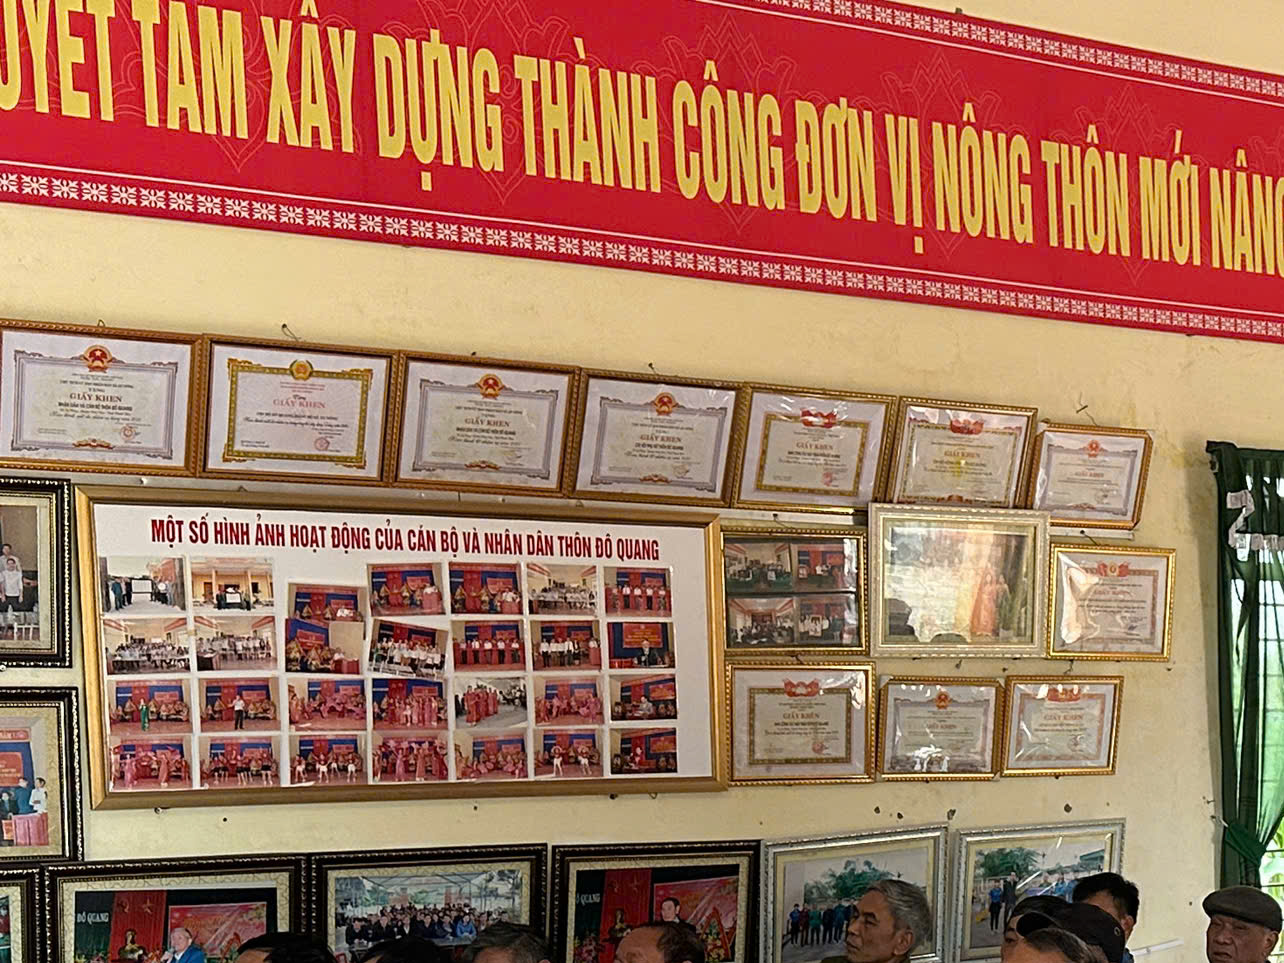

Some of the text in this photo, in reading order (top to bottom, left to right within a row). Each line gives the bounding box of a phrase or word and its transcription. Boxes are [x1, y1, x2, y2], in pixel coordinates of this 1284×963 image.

[262, 0, 355, 152] XÂY
[375, 30, 504, 189] DỰNG
[516, 40, 659, 191] THÀNH
[675, 64, 784, 208] CÔNG
[796, 98, 877, 221] ĐƠN
[887, 116, 923, 254] VỊ
[932, 102, 1033, 243] NÔNG
[1042, 125, 1130, 256] THÔN
[1140, 130, 1200, 265] MỚI
[69, 392, 92, 401] GIẤY
[299, 400, 326, 409] KHEN
[151, 513, 659, 561] MỘT SỐ HÌNH ẢNH HOẠT ĐỘNG CỦA CÁN BỘ VÀ NHÂN DÂN THÔN ĐÔ QUANG
